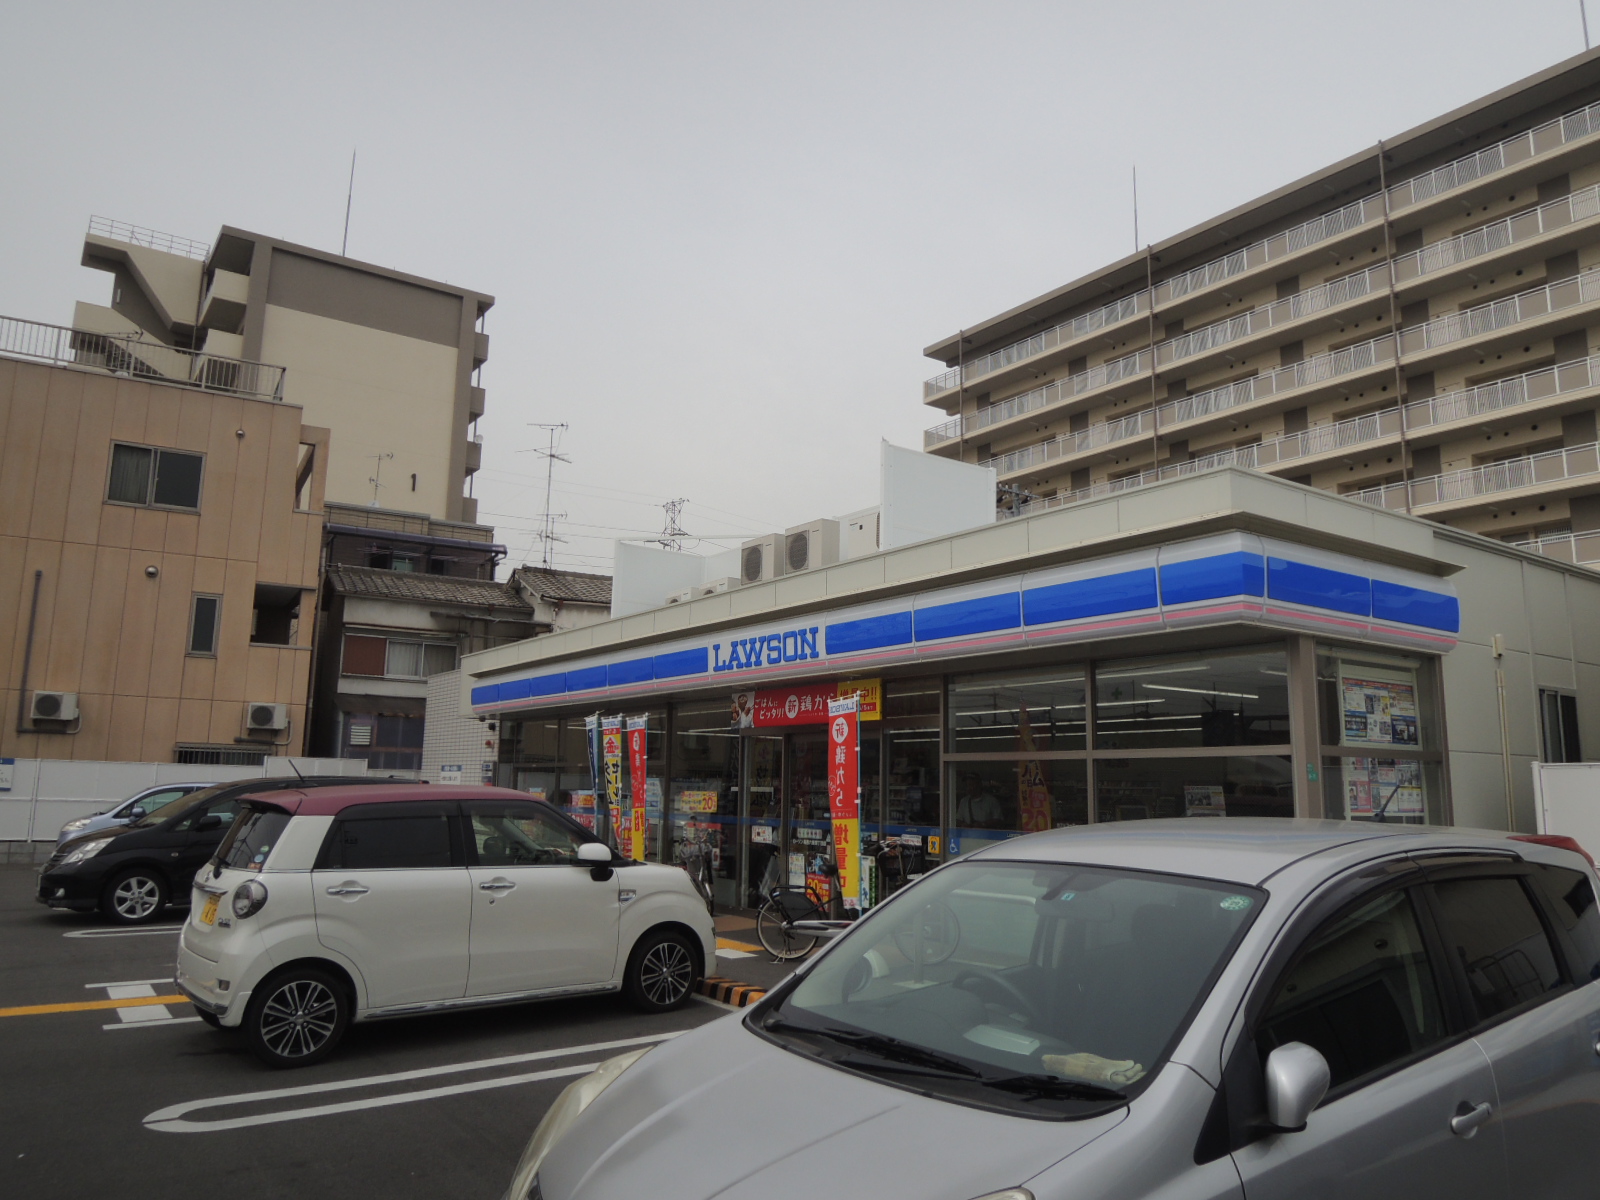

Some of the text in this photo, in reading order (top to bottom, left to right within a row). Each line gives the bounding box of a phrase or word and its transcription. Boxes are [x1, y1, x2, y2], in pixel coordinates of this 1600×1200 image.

[712, 626, 820, 673] LAWSON
[754, 697, 778, 709] ごはんに
[759, 707, 785, 720] ピッタリ!
[702, 797, 713, 811] 20
